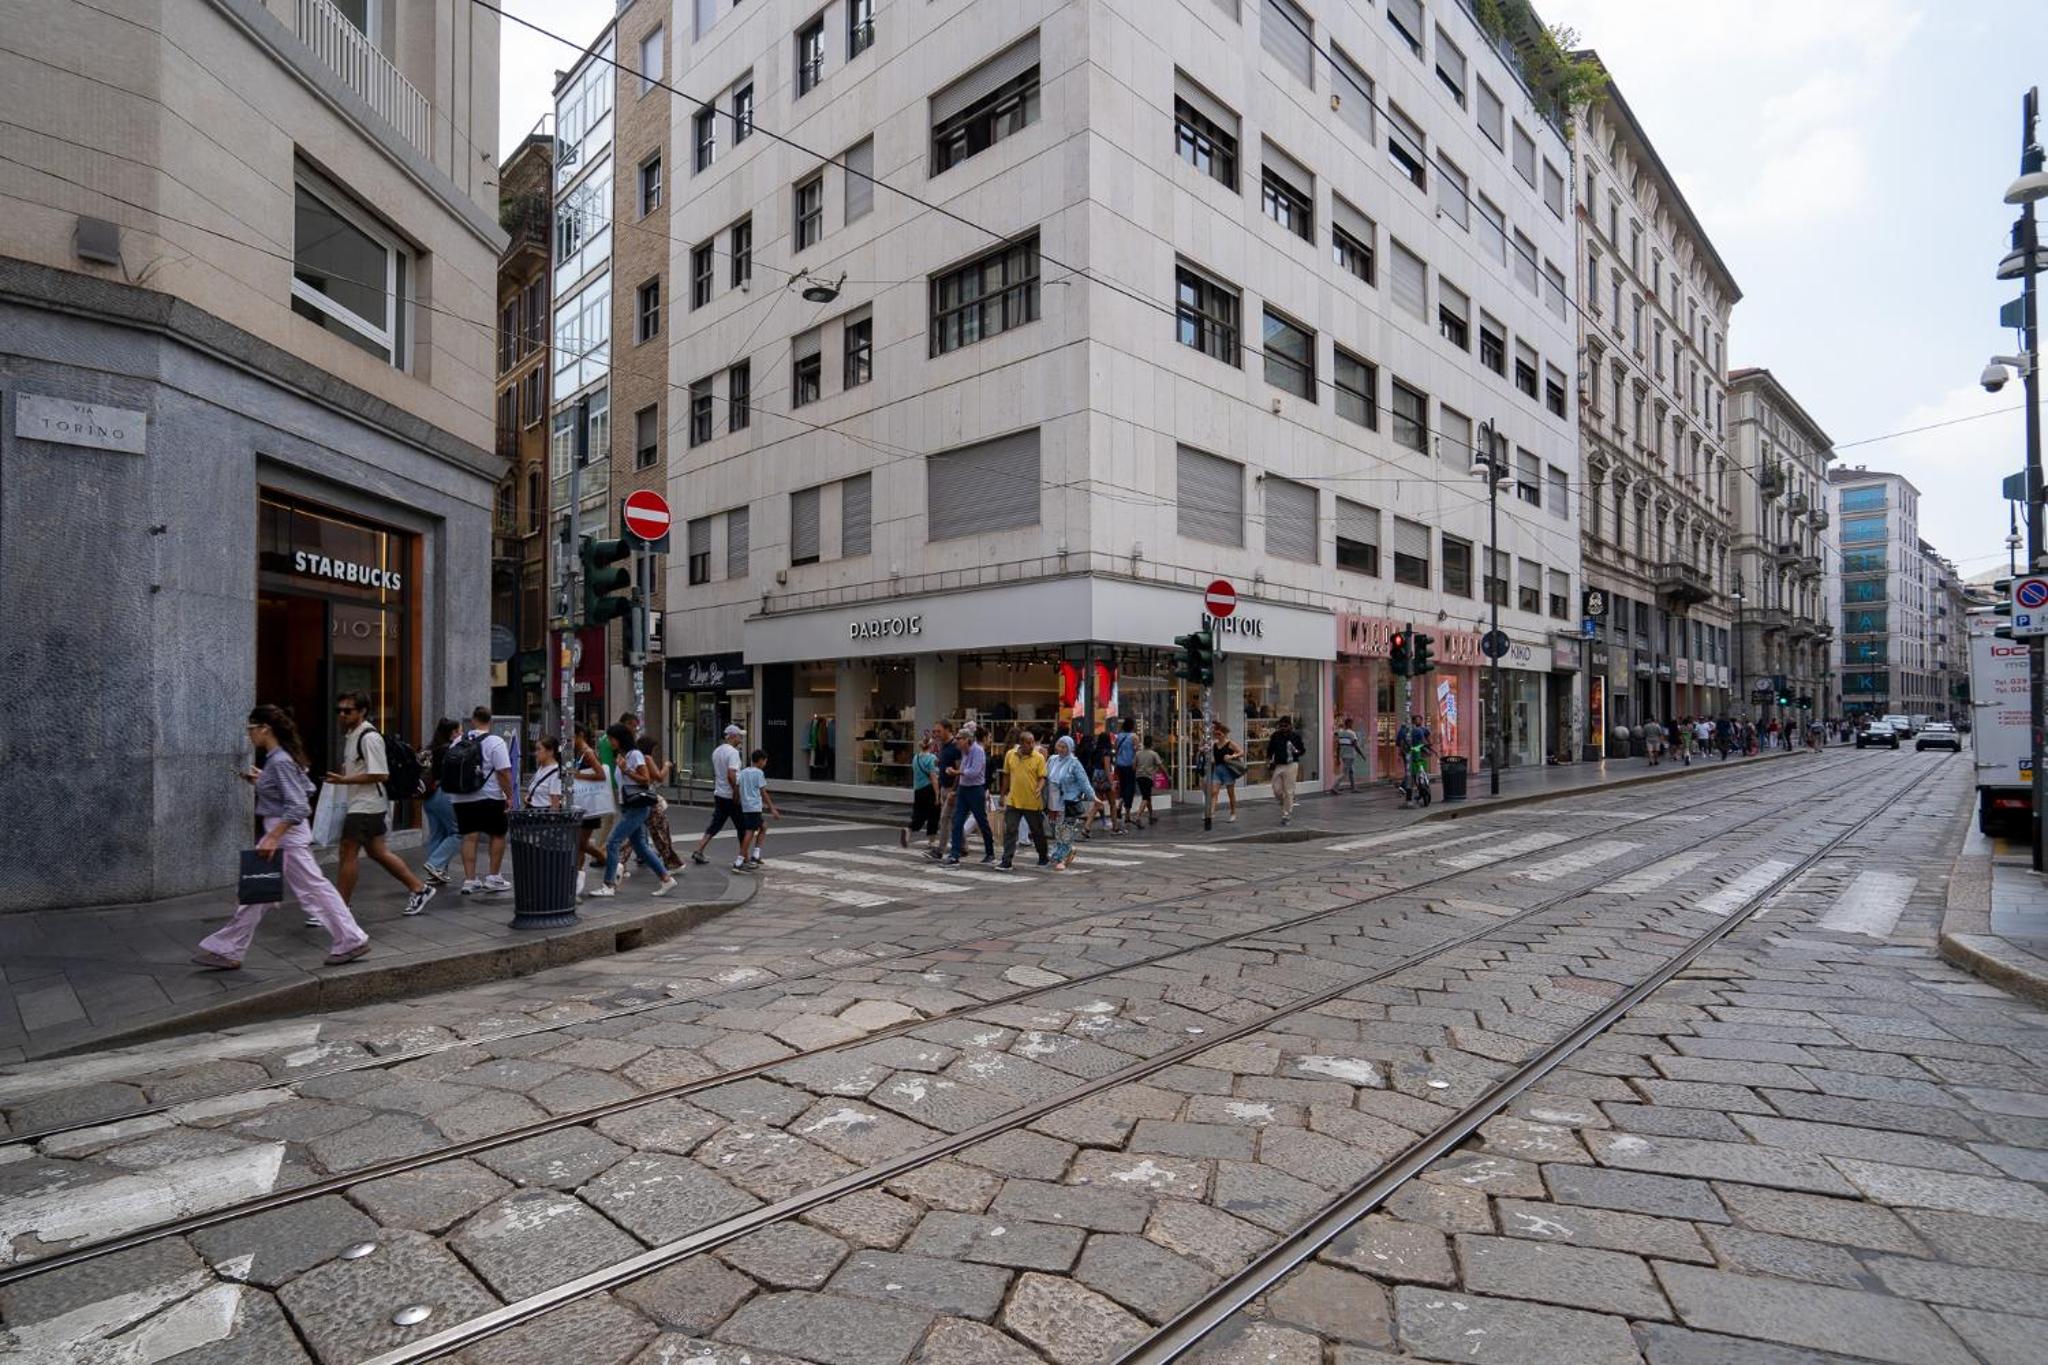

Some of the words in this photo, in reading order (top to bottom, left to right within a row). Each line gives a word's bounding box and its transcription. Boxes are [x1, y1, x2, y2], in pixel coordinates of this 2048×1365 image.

[73, 405, 94, 414] VIA
[42, 418, 124, 439] TORINO
[295, 550, 401, 591] STARBUCKS
[850, 616, 922, 639] PARFOIS
[1349, 620, 1399, 646] WYCO
[1511, 644, 1531, 661] KIKO
